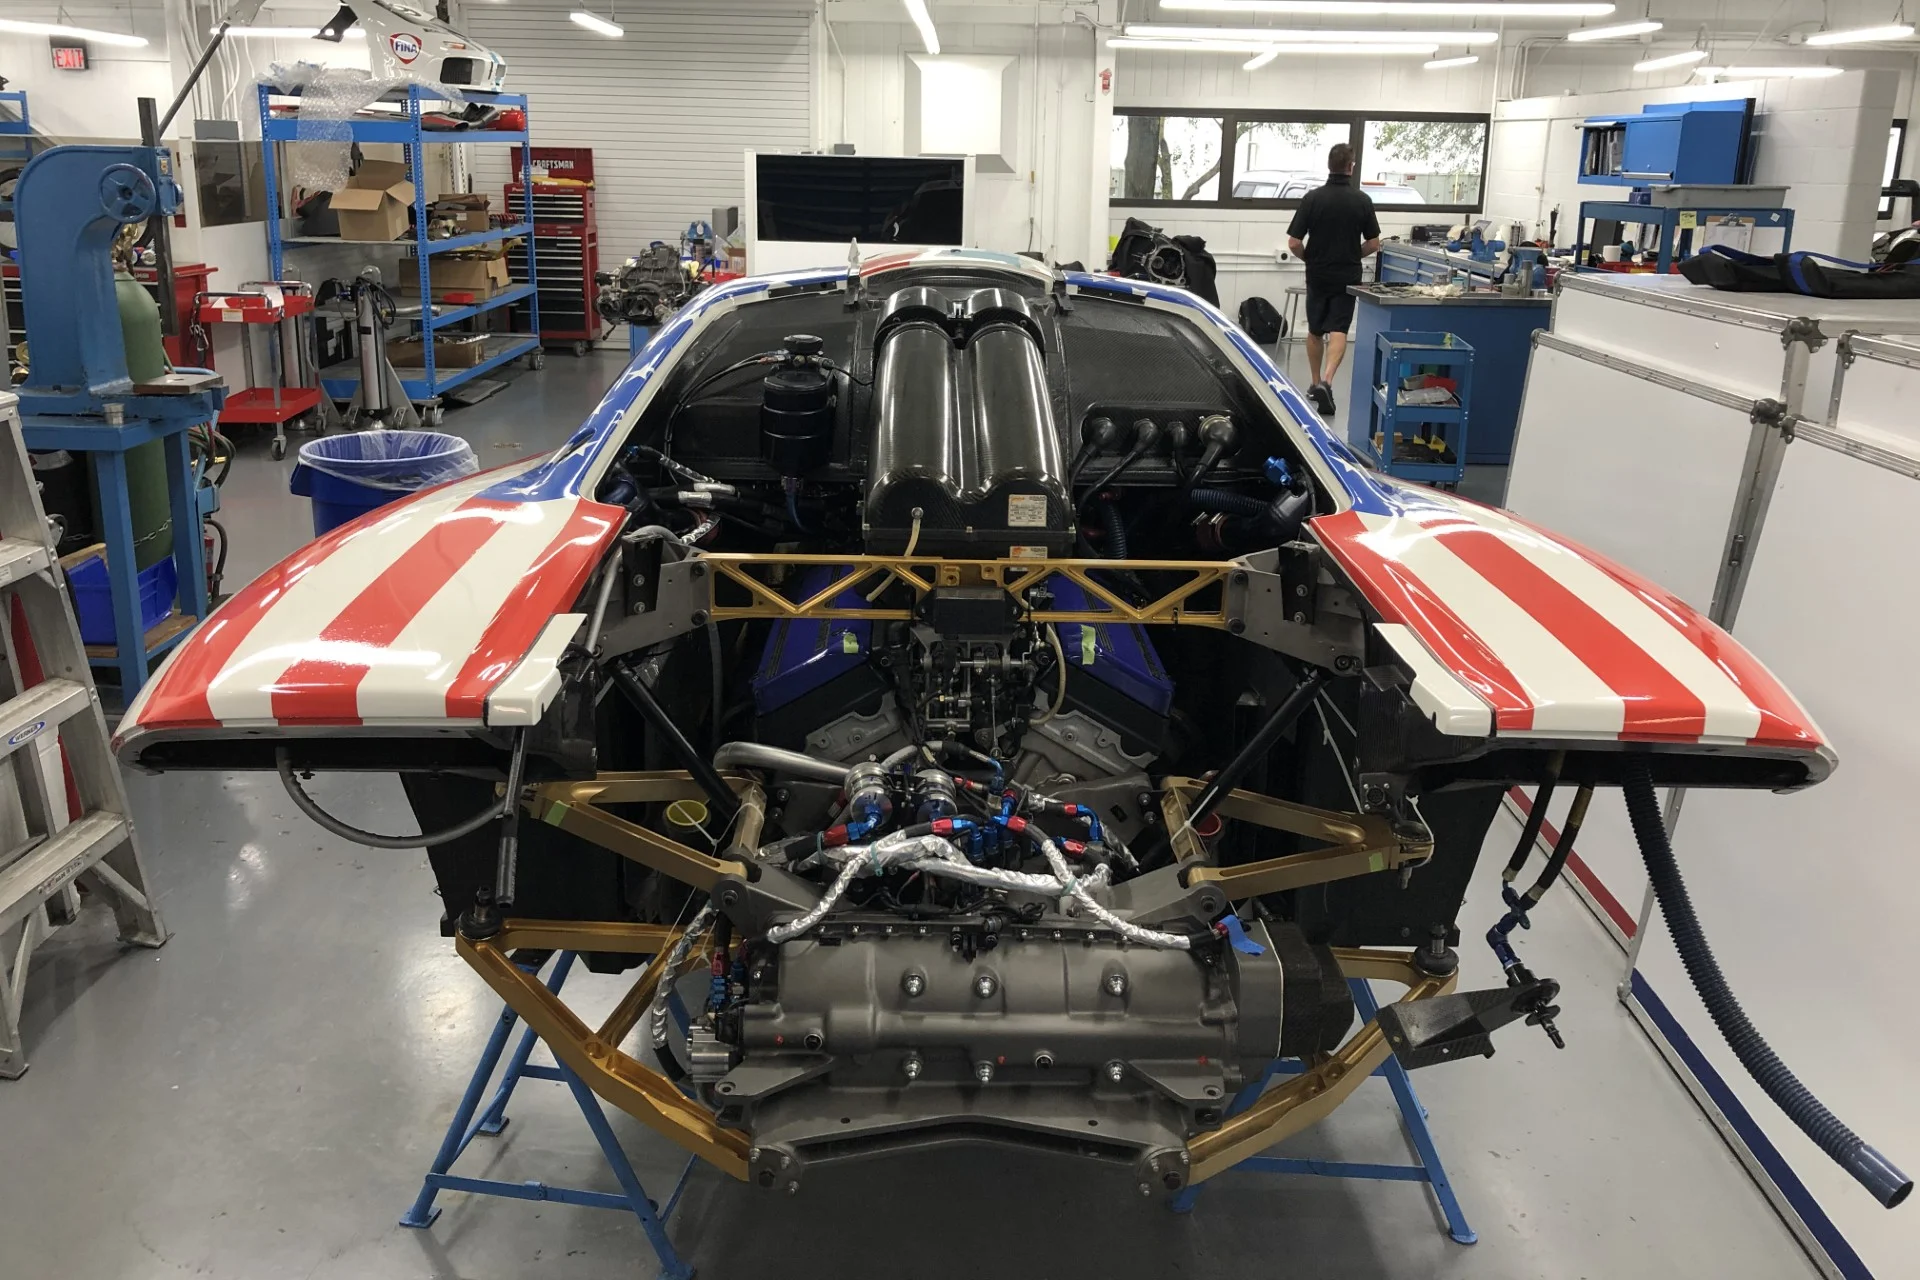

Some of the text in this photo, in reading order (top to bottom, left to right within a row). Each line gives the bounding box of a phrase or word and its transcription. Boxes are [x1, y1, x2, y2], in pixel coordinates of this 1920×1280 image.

[395, 41, 417, 53] FINA
[55, 49, 82, 67] EXIT
[532, 160, 574, 169] CRAFTSMAN
